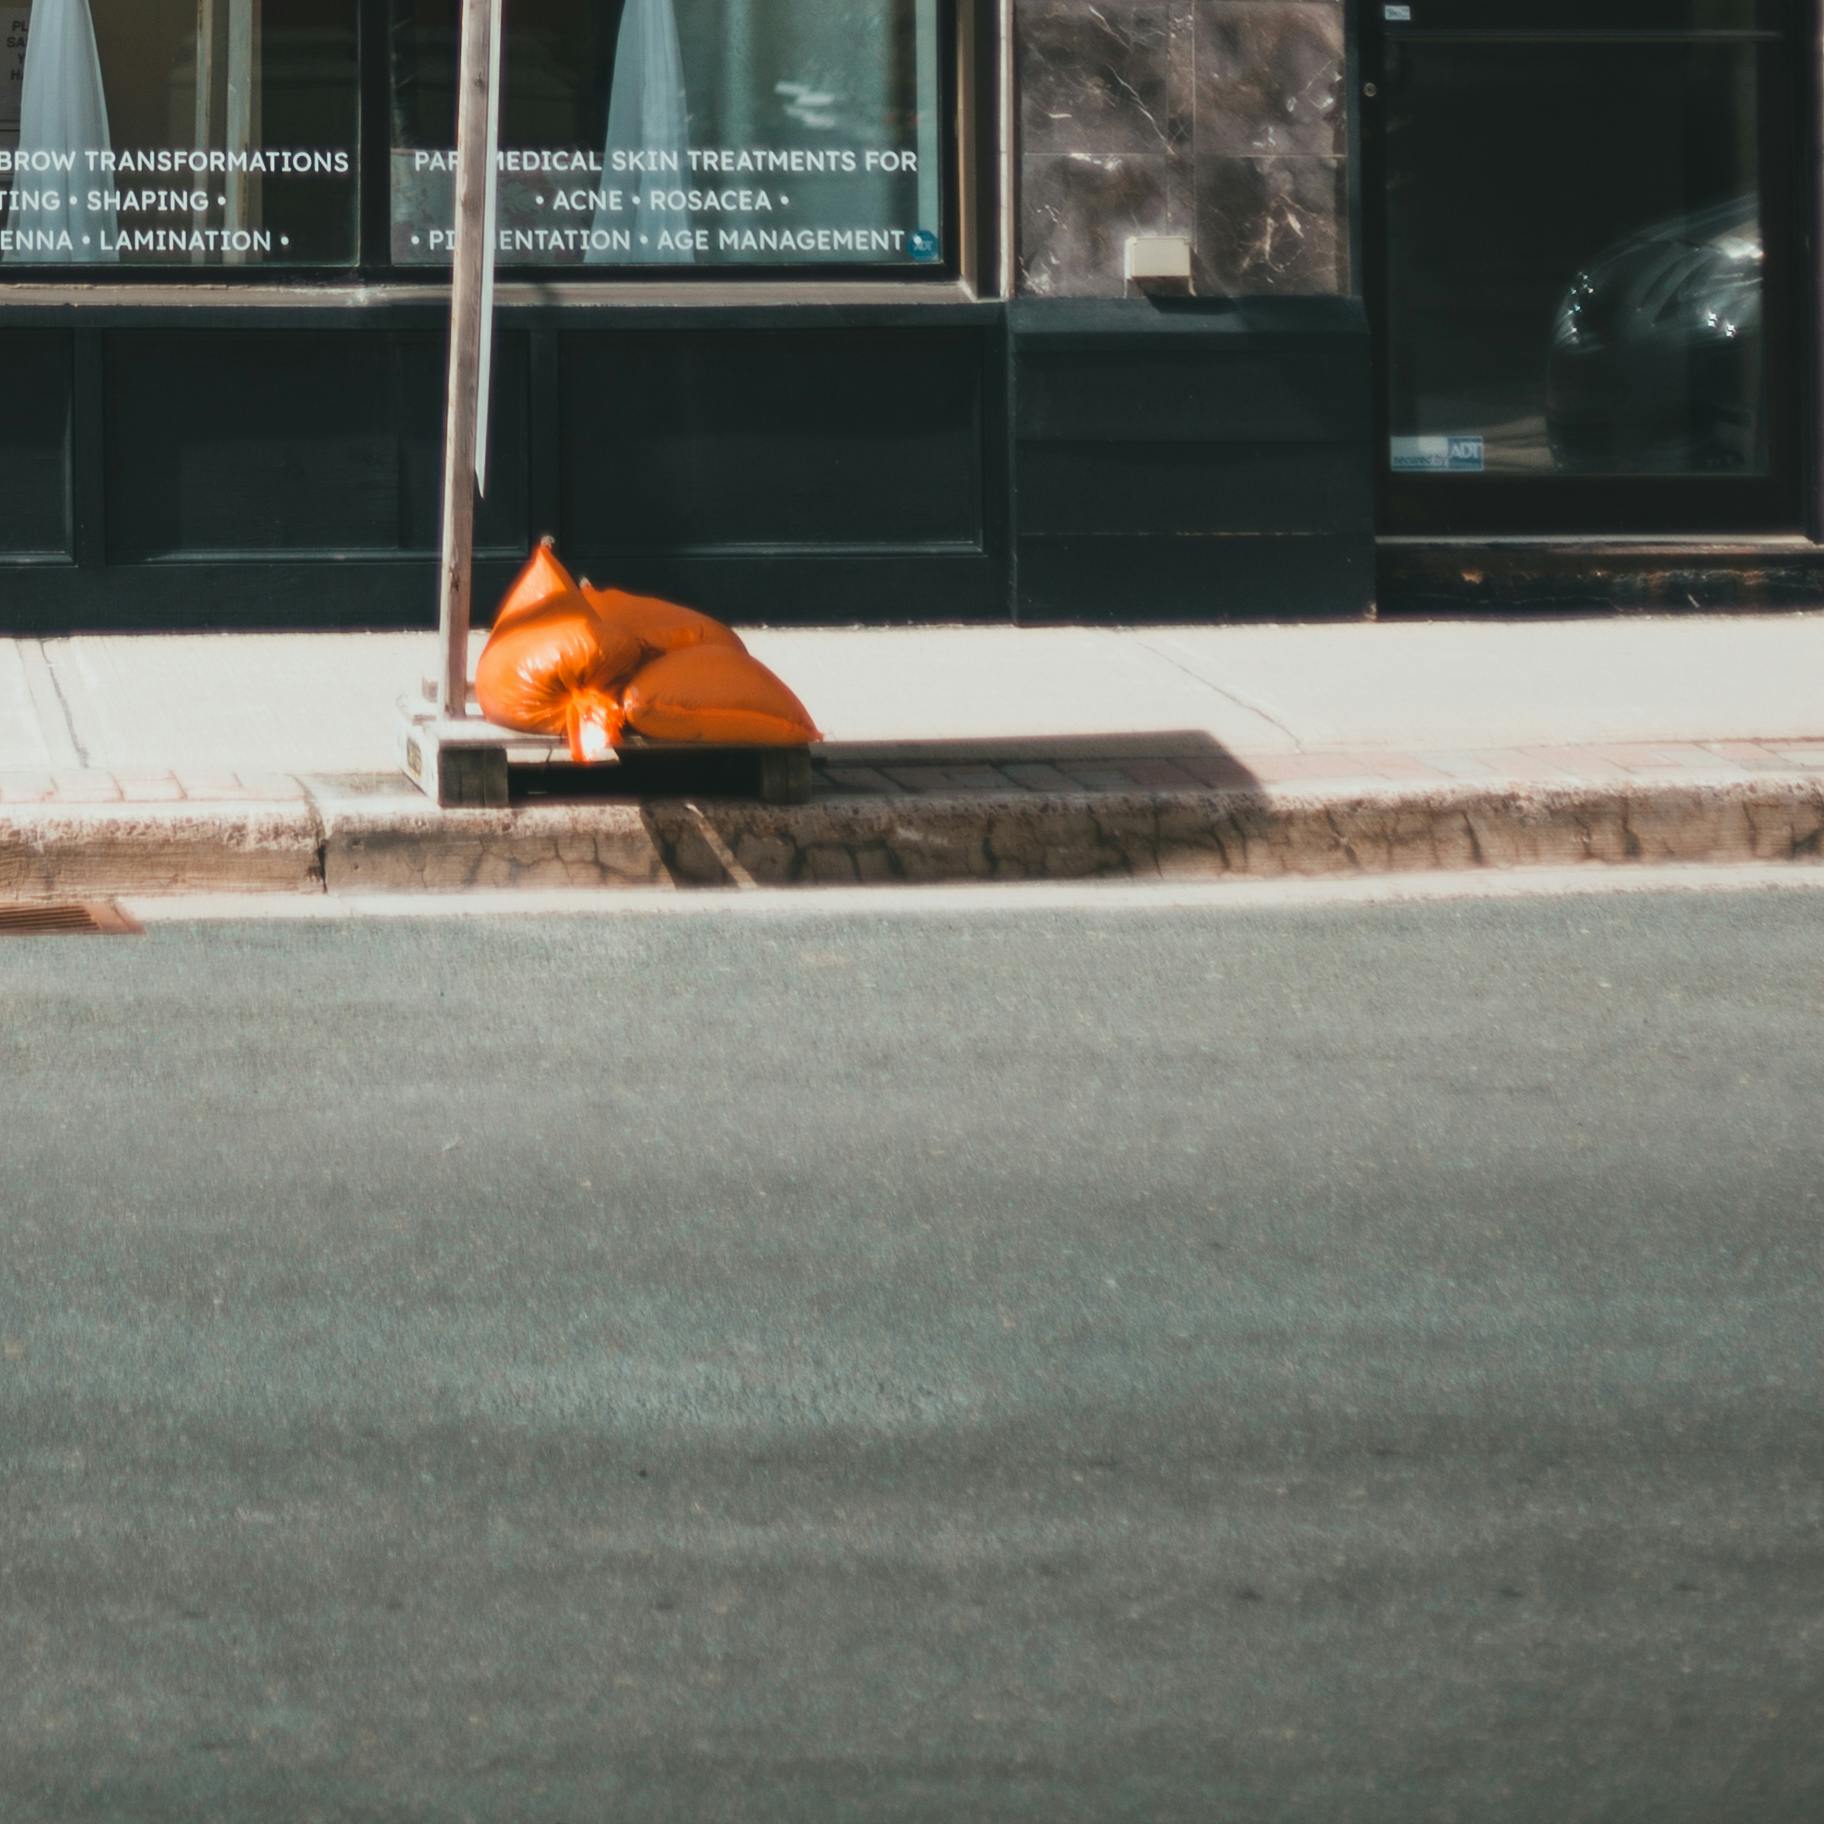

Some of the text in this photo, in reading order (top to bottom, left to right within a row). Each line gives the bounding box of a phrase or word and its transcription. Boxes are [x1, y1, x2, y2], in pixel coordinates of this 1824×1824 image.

[85, 151, 349, 173] TRANSFORMATIONS
[612, 151, 678, 172] SKIN
[687, 151, 857, 172] TREATMENTS
[866, 151, 917, 172] FOR
[87, 191, 209, 212] SHAPING
[553, 190, 773, 211] ACNE ROSACEA
[100, 230, 271, 251] LAMINATION
[429, 230, 630, 251] PIENTATION
[657, 230, 709, 251] AGE
[719, 230, 905, 251] MANAGEMENT
[1450, 441, 1482, 459] ADT
